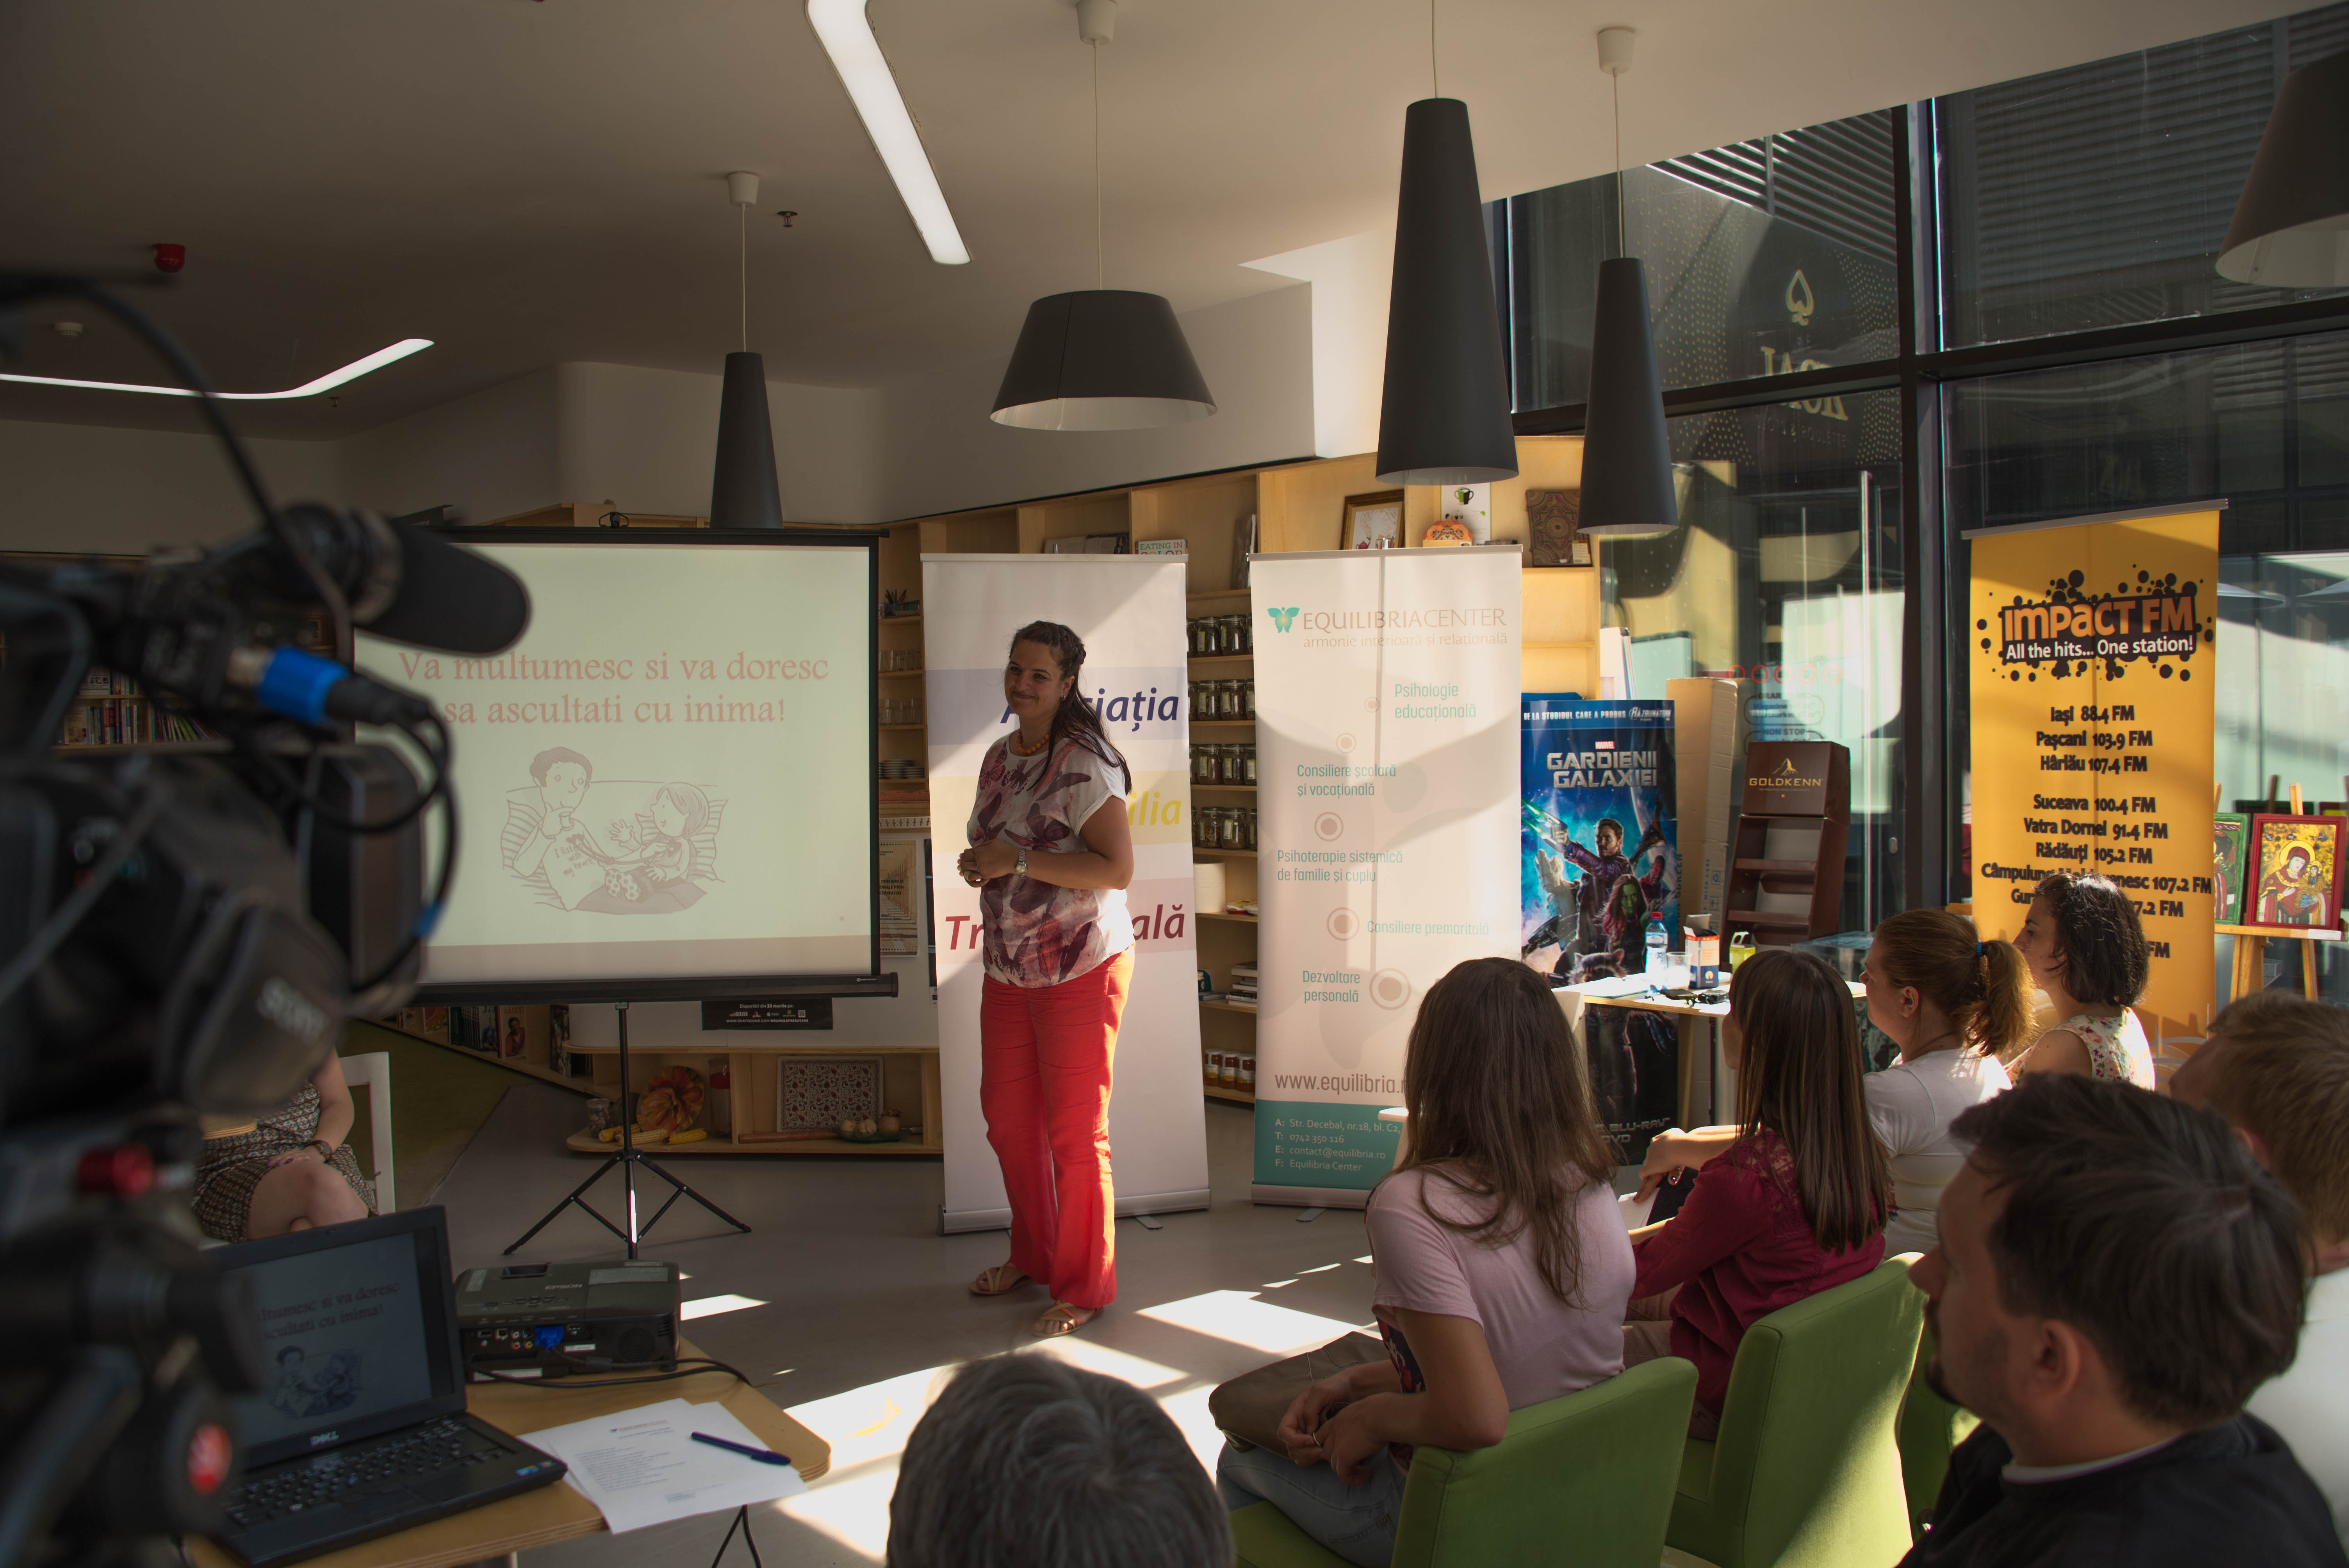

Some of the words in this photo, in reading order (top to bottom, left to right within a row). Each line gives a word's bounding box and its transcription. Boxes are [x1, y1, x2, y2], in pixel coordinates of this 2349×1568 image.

[1139, 542, 1171, 550] EATING
[2142, 596, 2193, 633] FM
[1303, 635, 1356, 648] armonie
[1361, 634, 1422, 647] interioară
[2006, 643, 2025, 660] All
[2028, 642, 2051, 659] the
[2054, 641, 2094, 657] hits...
[2097, 639, 2128, 656] One
[2132, 635, 2194, 654] station!
[398, 652, 442, 681] Va
[453, 651, 633, 681] multumesc
[645, 651, 669, 680] si
[679, 659, 717, 680] va
[726, 651, 828, 680] doresc
[1394, 683, 1459, 700] Psihologie
[444, 702, 477, 723] sa
[488, 693, 623, 723] ascultati
[634, 702, 673, 723] cu
[684, 694, 784, 723] inima!
[1524, 712, 1531, 720] DE
[1532, 712, 1540, 720] LA
[1542, 711, 1573, 720] STUDIOUL
[1576, 711, 1592, 719] CARE
[1594, 711, 1599, 719] A
[1601, 710, 1627, 718] PRODUS
[2080, 705, 2109, 724] 88.4
[2112, 705, 2135, 721] FM
[1595, 741, 1615, 750] MARVEL
[2092, 733, 2125, 750] 103.9
[2129, 731, 2153, 746] FM
[1547, 750, 1657, 770] GARDIENII
[2041, 755, 2085, 771] Hârlău
[2088, 758, 2121, 775] 107.4
[2124, 756, 2148, 772] FM
[1297, 764, 1352, 778] Consiliere
[1553, 769, 1657, 789] GALAXIEI
[1749, 778, 1821, 786] GOLDKENN
[2034, 794, 2089, 811] Suceava
[2094, 798, 2128, 815] 100.4
[2132, 796, 2157, 813] FM
[2024, 818, 2058, 834] Vatra
[2061, 819, 2107, 836] Dornei
[2112, 824, 2140, 841] 91.4
[2144, 822, 2168, 839] FM
[1277, 850, 1346, 865] Psihoterapie
[1349, 850, 1403, 864] sistemică
[2094, 848, 2126, 865] 105.2
[2129, 847, 2153, 864] FM
[1277, 868, 1290, 881] de
[1294, 868, 1330, 881] familie
[1346, 869, 1376, 884] cuplu
[1981, 863, 2054, 883] Câmpulun
[2152, 877, 2189, 895] 107.2
[2192, 877, 2212, 894] FM
[2159, 900, 2184, 918] FM
[1367, 920, 1422, 934] Consiliere
[1425, 922, 1489, 937] premaritală
[1303, 970, 1360, 985] Dezvoltare
[1304, 988, 1359, 1005] personală
[1275, 1073, 1406, 1095] www.equilibria.r
[1290, 1119, 1305, 1128] Str.
[1307, 1120, 1344, 1131] Decebal,
[1347, 1123, 1371, 1132] nr.18,
[1374, 1123, 1385, 1131] bl.
[1275, 1132, 1283, 1140] T:
[1290, 1134, 1310, 1142] 0742
[1312, 1135, 1327, 1144] 350
[1329, 1135, 1344, 1143] 116
[1275, 1146, 1284, 1154] E:
[1290, 1147, 1386, 1159] contact@equilibria.ro
[1275, 1159, 1283, 1167] F:
[1290, 1160, 1330, 1170] Equilibria
[1332, 1162, 1362, 1171] Center
[335, 1293, 352, 1304] va
[355, 1282, 400, 1301] doresc
[310, 1431, 339, 1446] DELL
